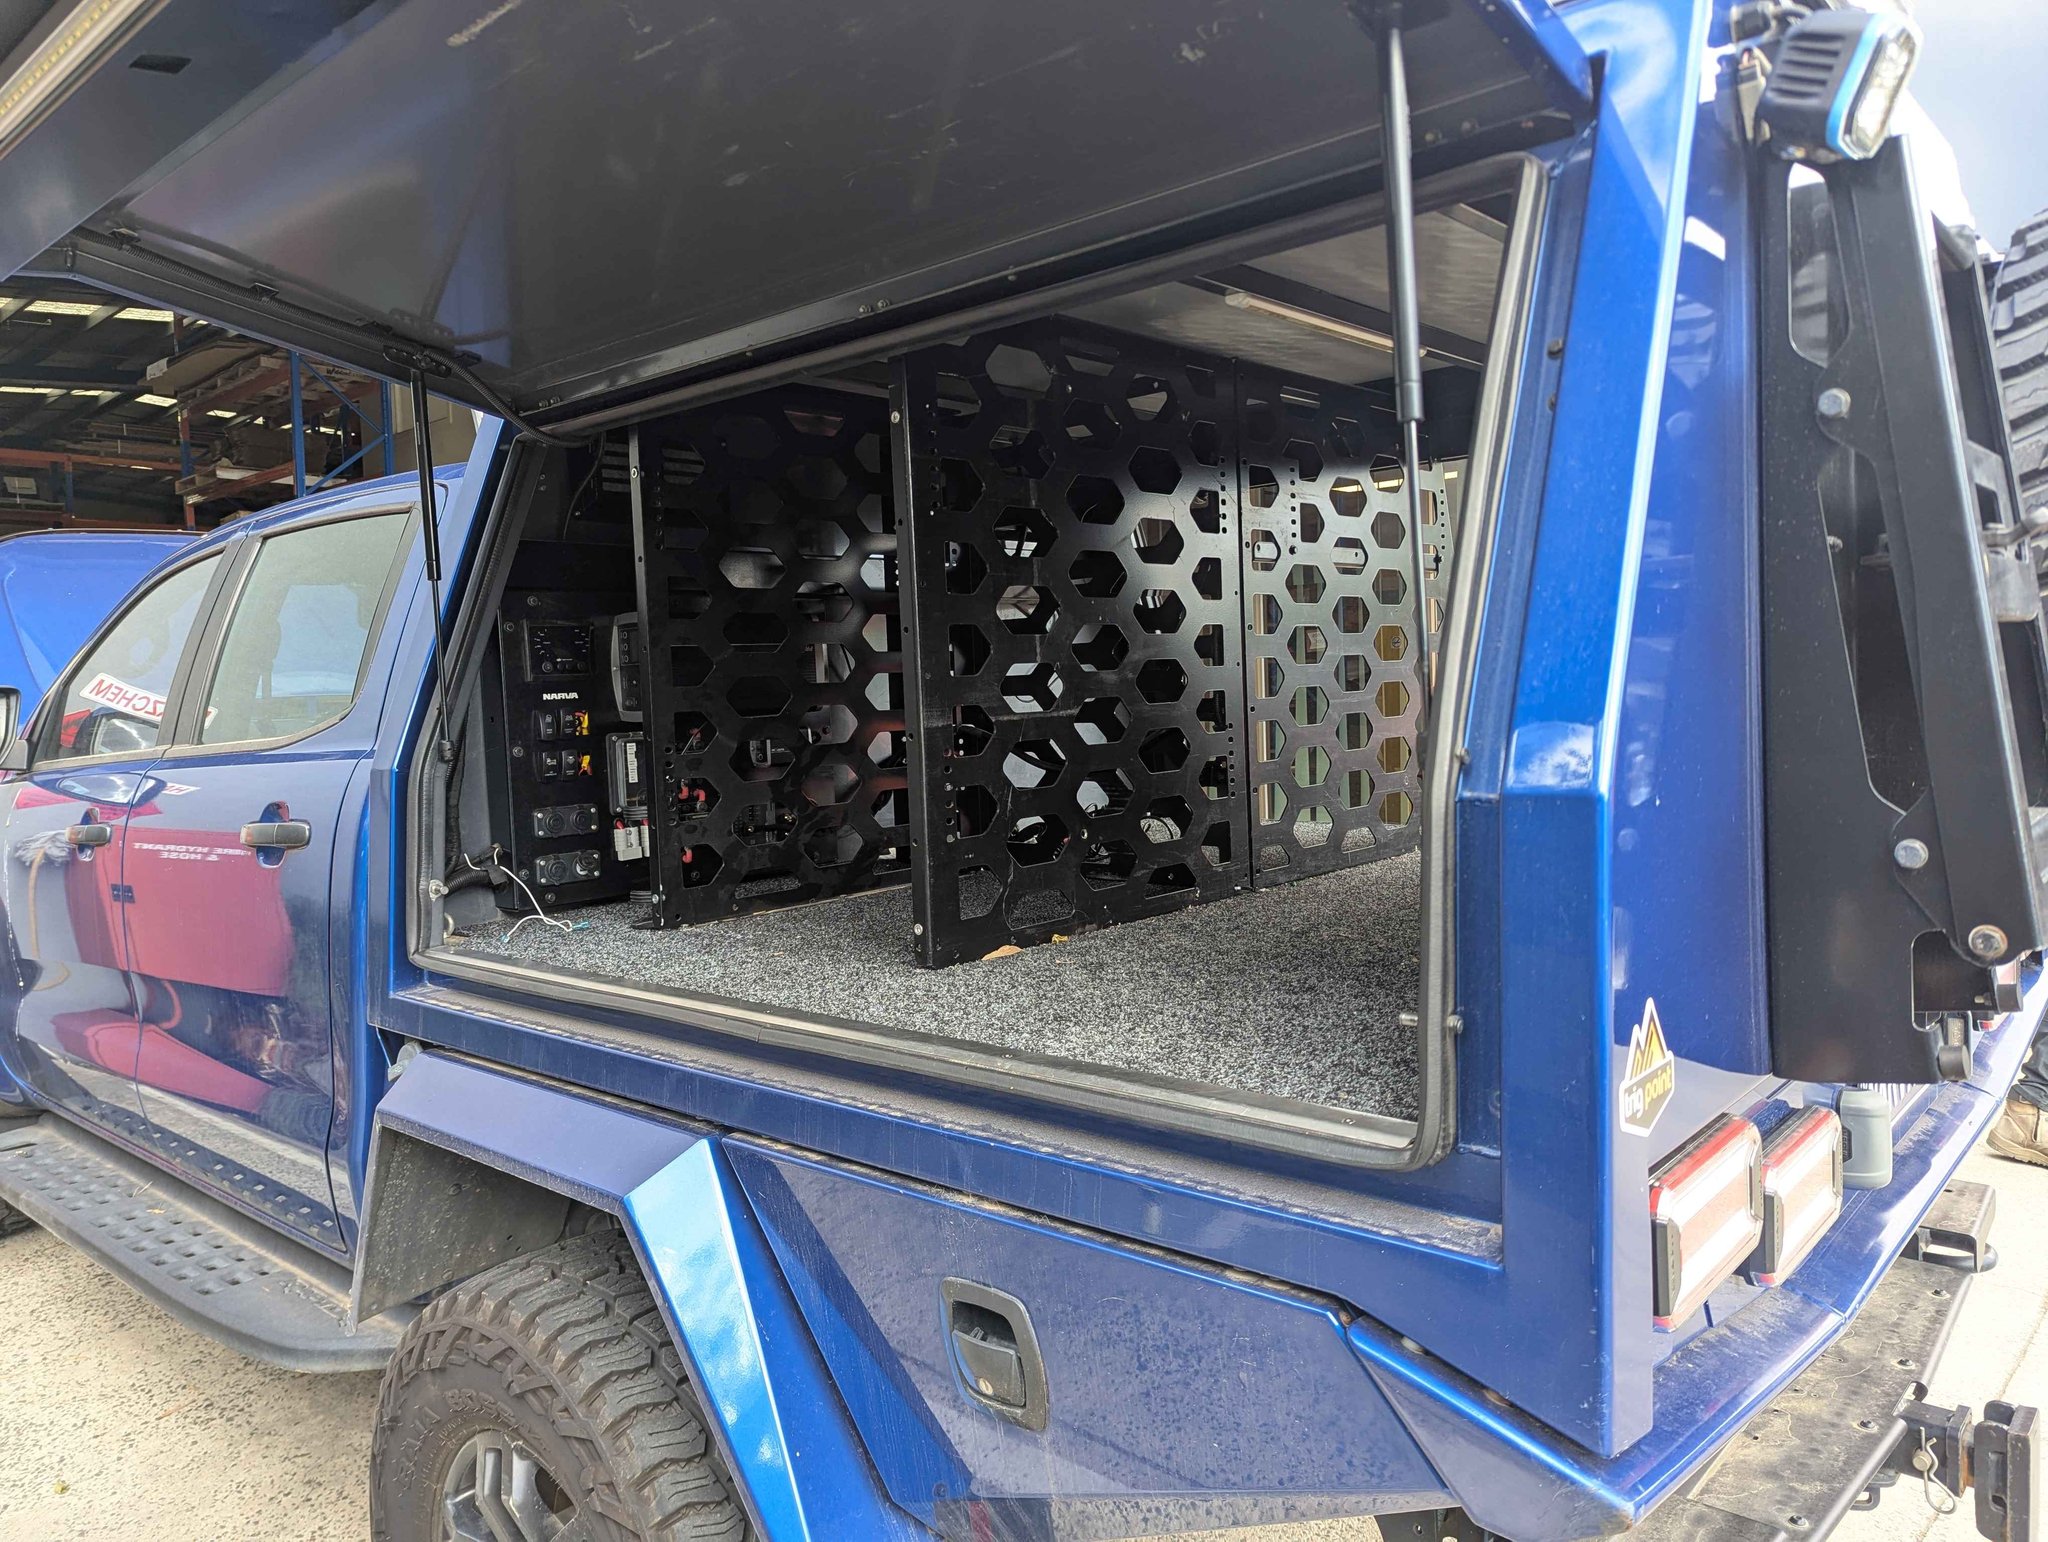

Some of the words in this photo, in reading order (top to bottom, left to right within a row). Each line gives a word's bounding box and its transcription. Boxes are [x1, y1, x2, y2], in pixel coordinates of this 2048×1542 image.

[542, 692, 579, 701] NARVA
[1624, 1085, 1644, 1119] trig
[1645, 1065, 1672, 1111] point
